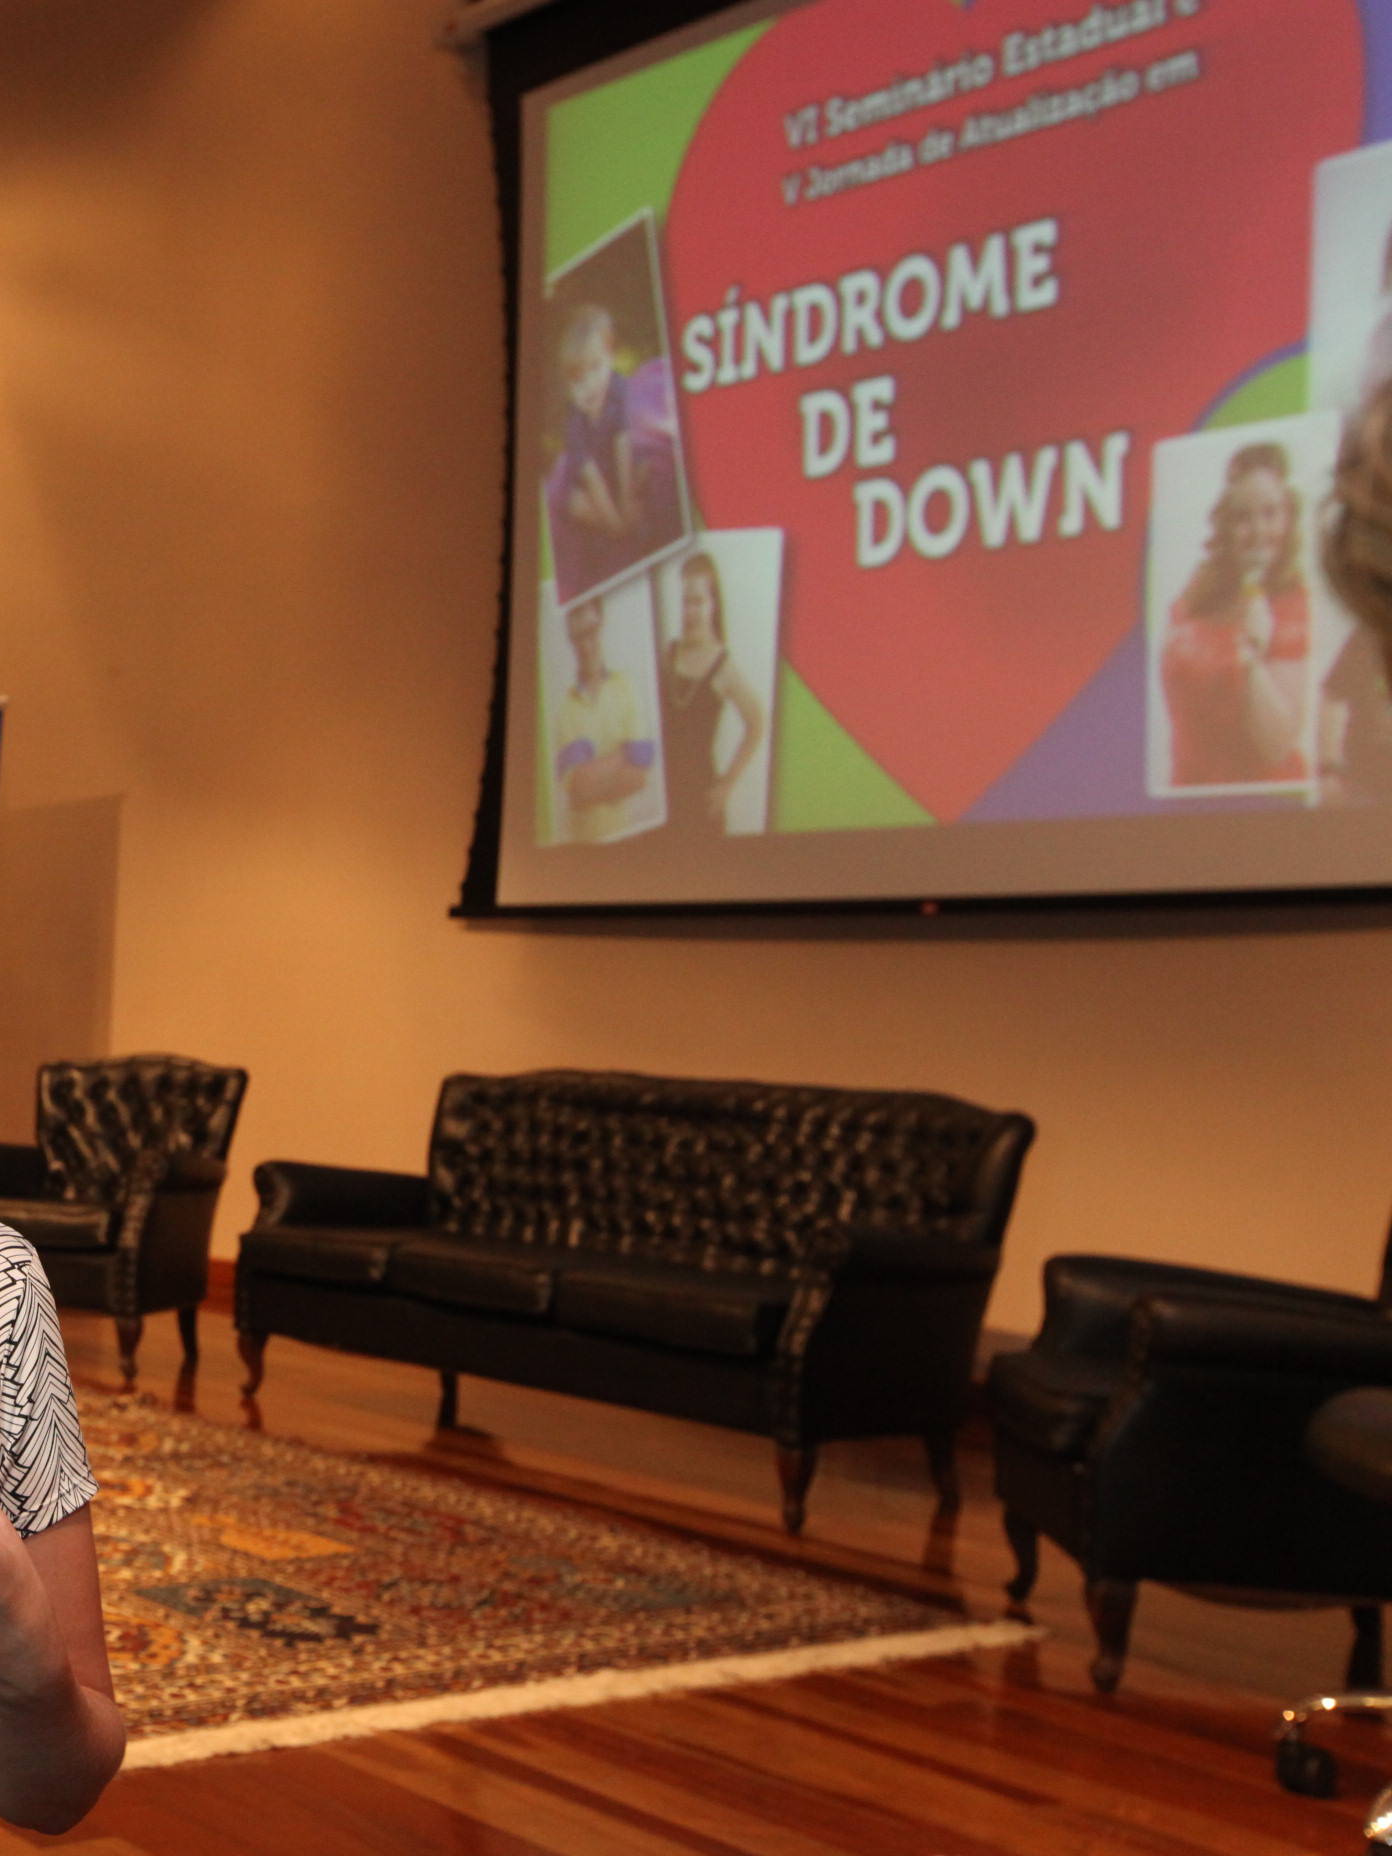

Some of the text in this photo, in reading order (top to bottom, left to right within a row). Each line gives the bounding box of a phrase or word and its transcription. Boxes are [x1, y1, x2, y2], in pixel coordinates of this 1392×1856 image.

[805, 138, 915, 200] Jornada
[919, 128, 955, 164] de
[959, 68, 1141, 150] Atualização
[1145, 49, 1200, 92] em
[825, 50, 995, 137] Seminário
[1002, 0, 1167, 77] Estadual
[680, 217, 1060, 394] SÍNDROME
[799, 374, 896, 480] DE
[852, 430, 1130, 570] DOWN
